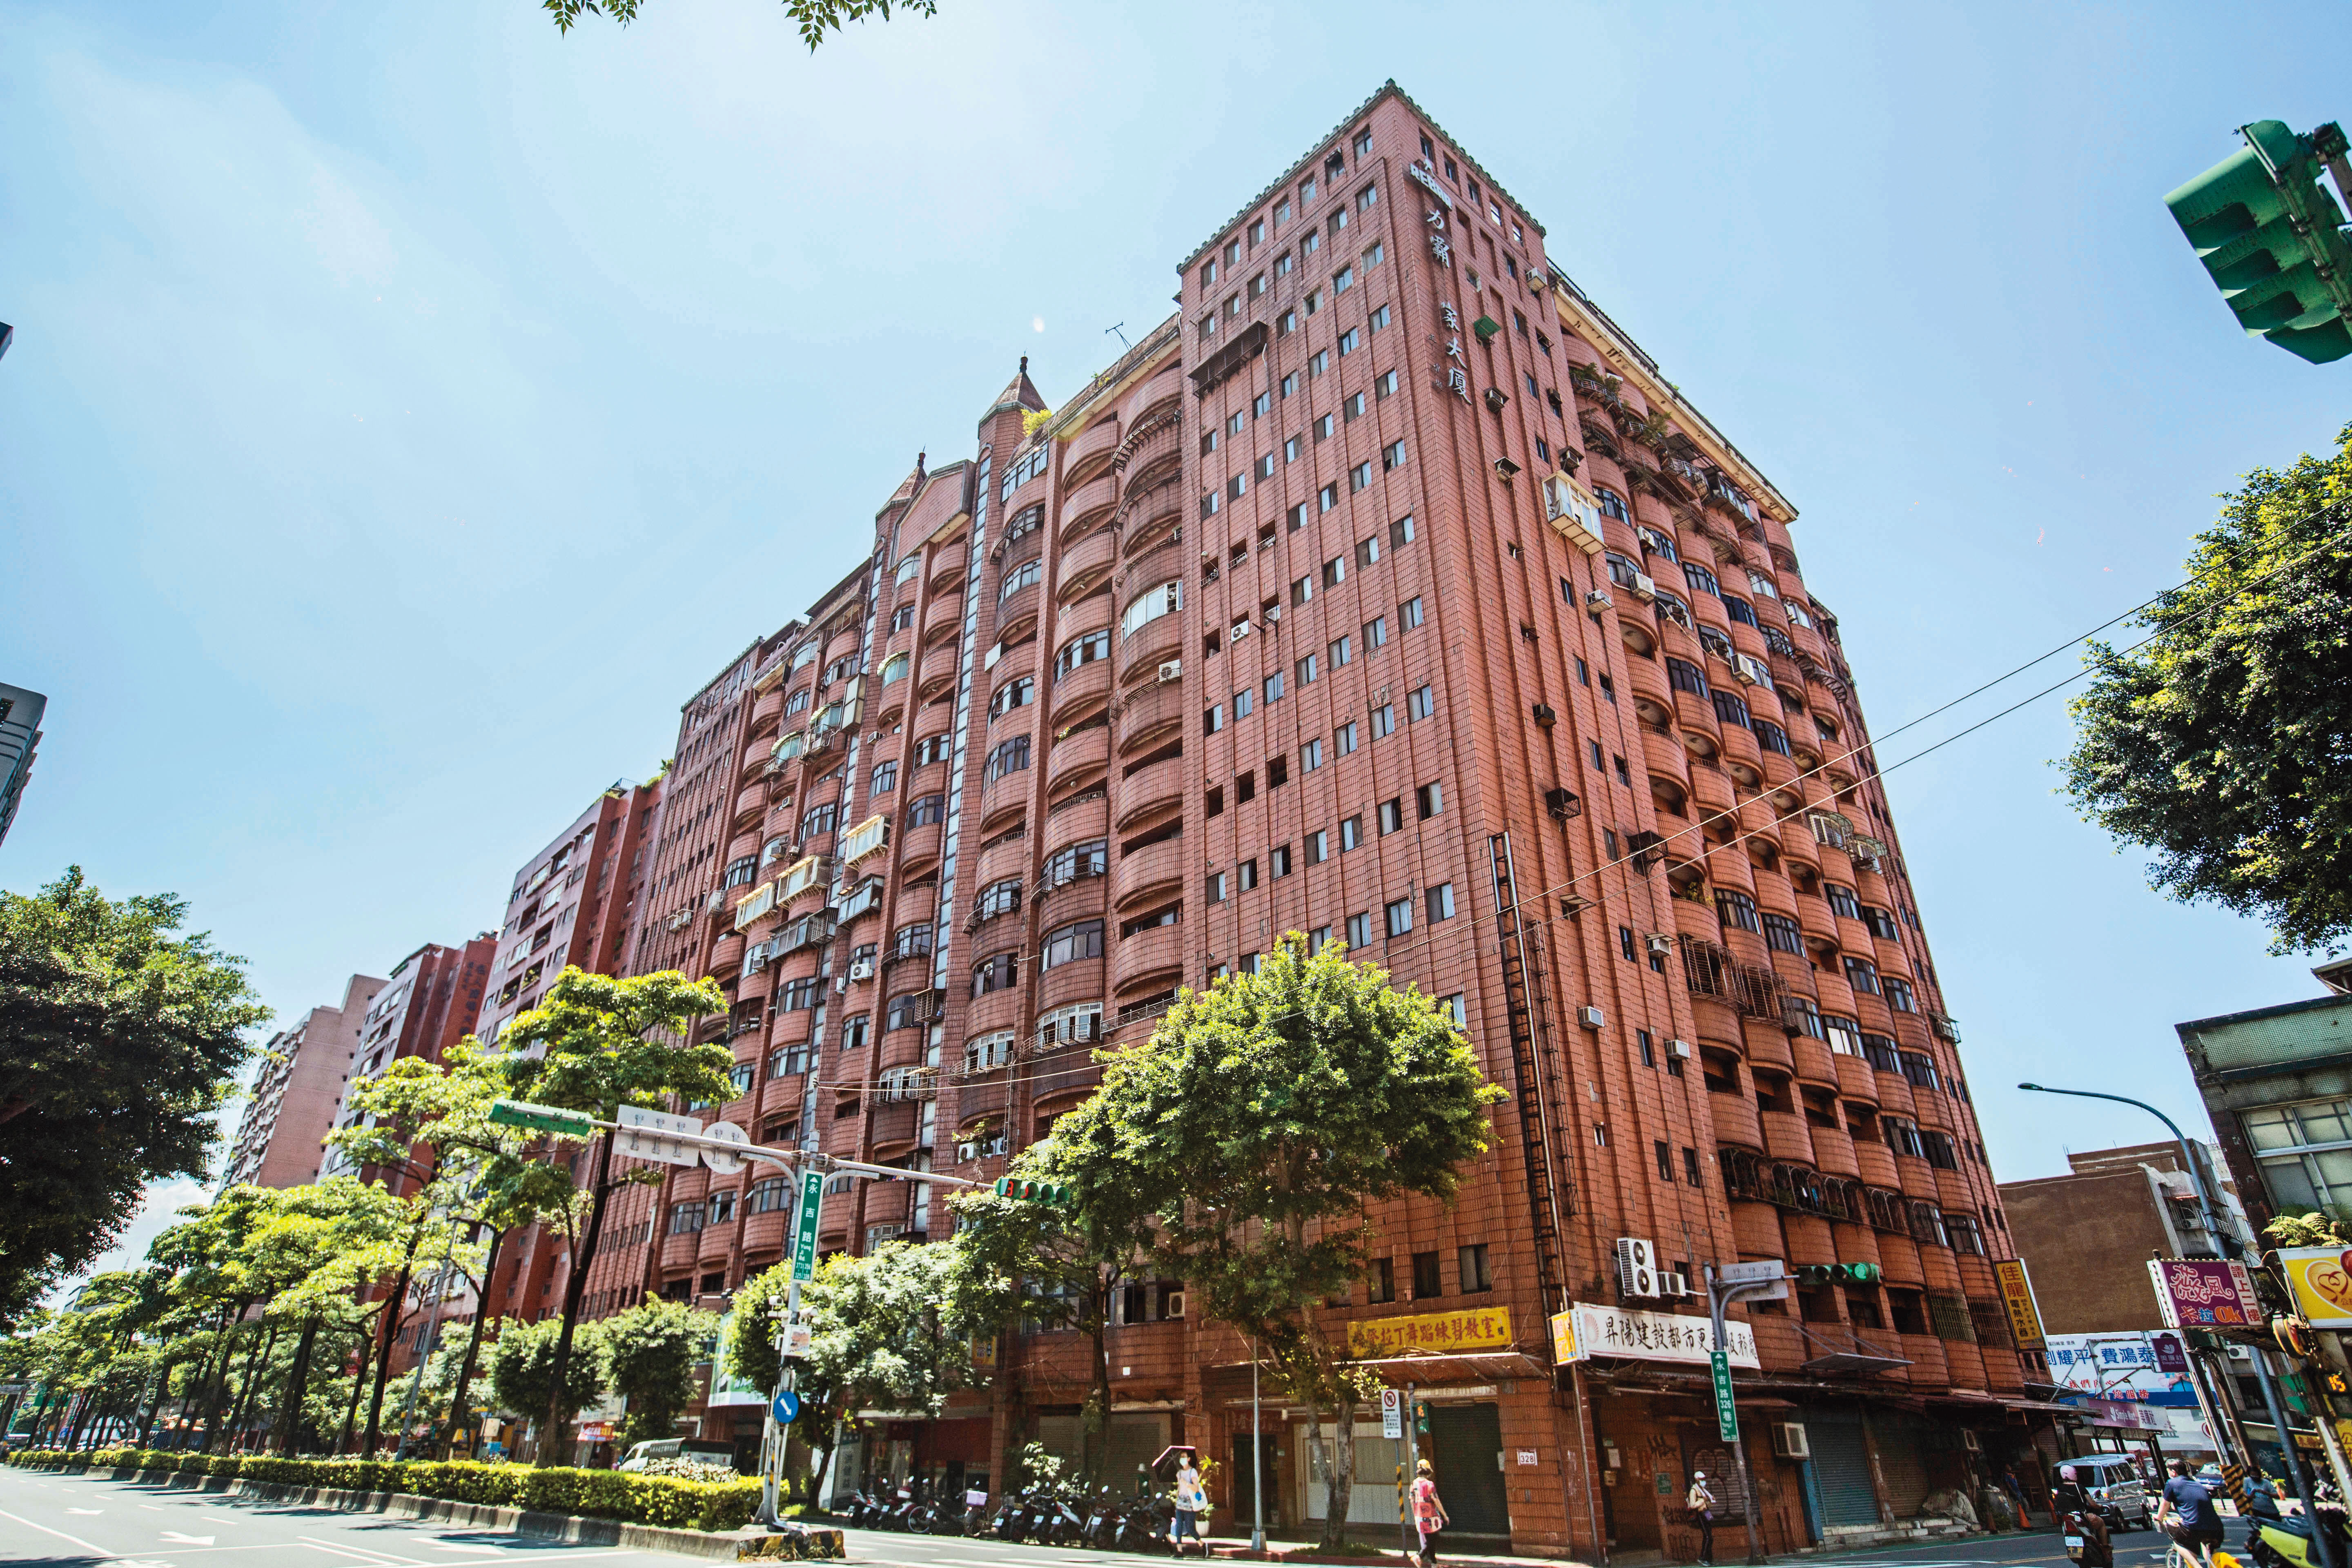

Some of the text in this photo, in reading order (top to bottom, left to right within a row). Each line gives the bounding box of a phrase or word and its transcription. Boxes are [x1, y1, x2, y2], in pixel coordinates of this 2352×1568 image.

[1410, 163, 1452, 210] REBAR
[802, 1183, 818, 1243] 永吉路
[2230, 1265, 2261, 1322] 請上二樓
[1604, 1316, 1757, 1359] 昇陽建設都市更服務處
[2045, 1347, 2158, 1365] 劉耀平 費鴻泰
[2328, 1374, 2346, 1392] 15
